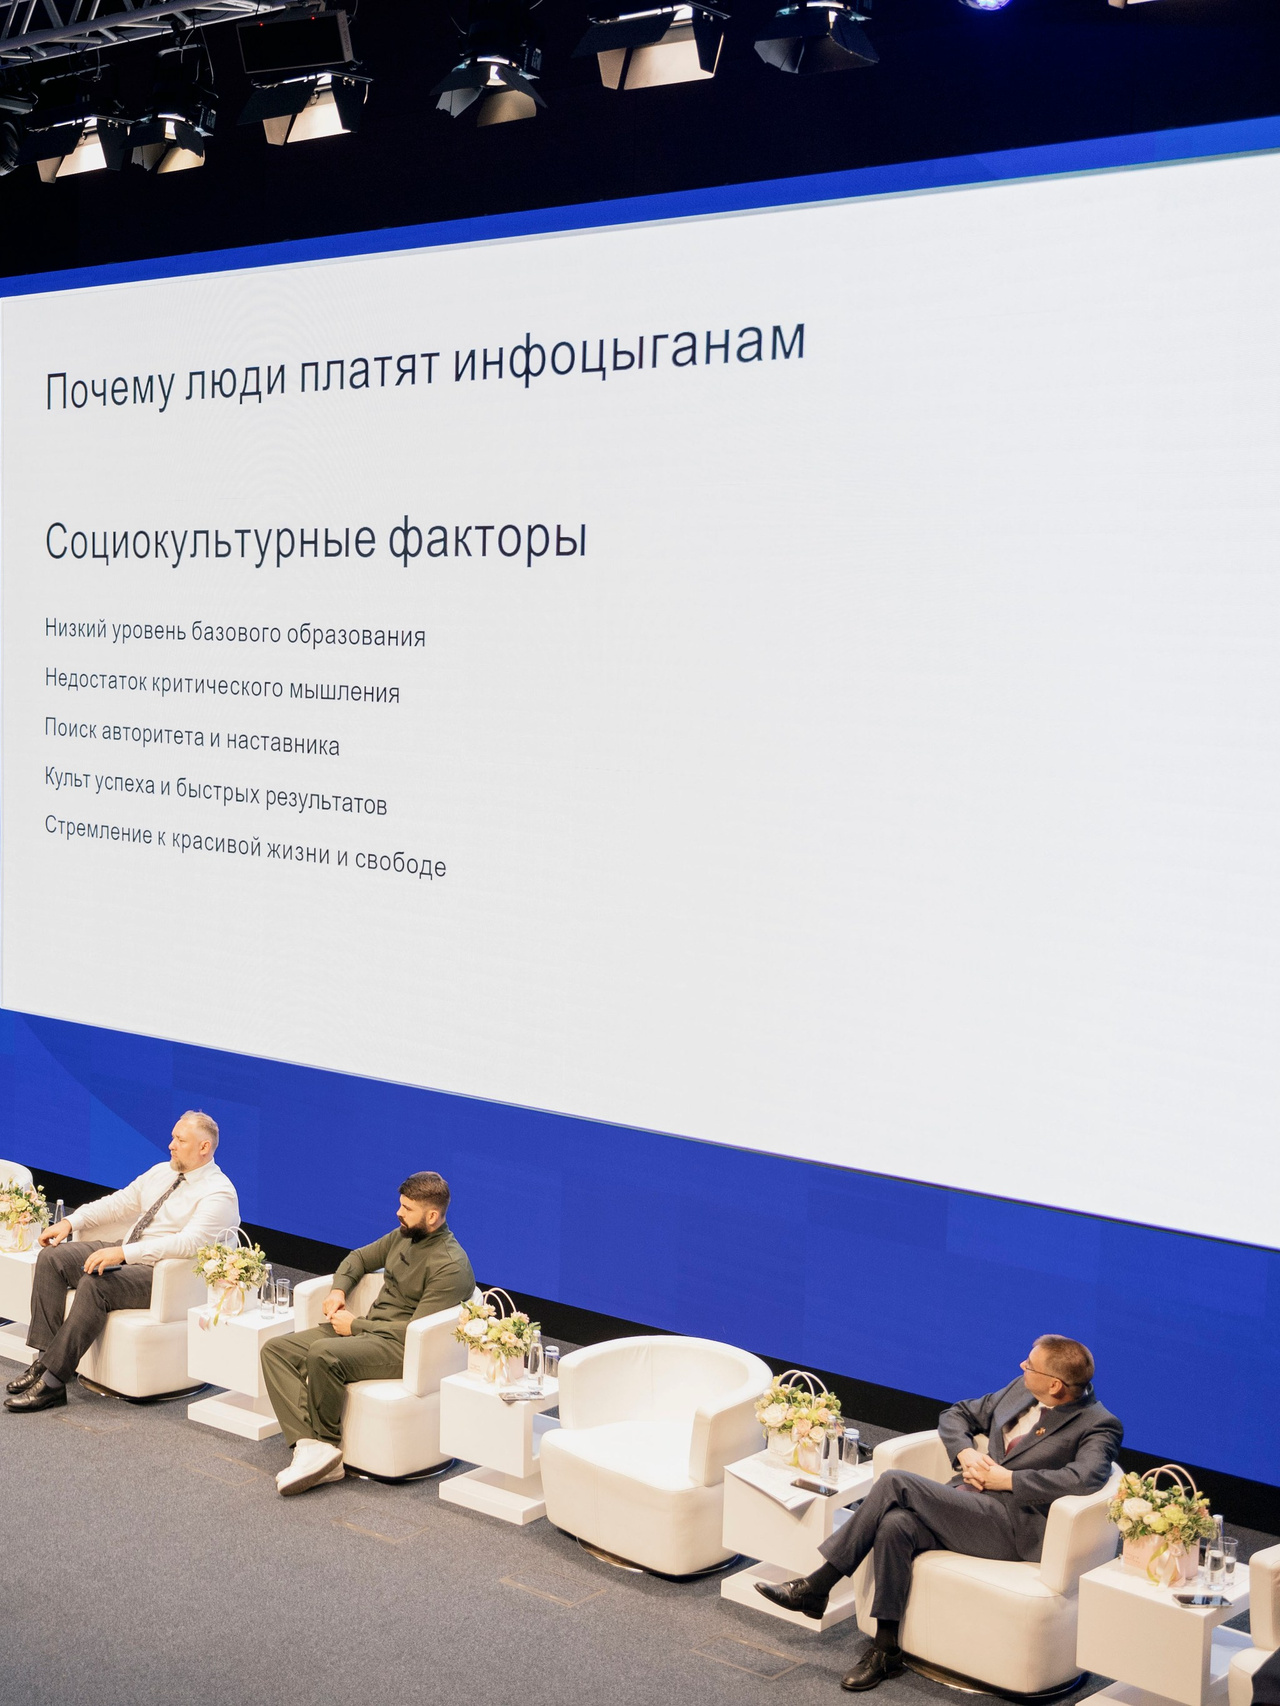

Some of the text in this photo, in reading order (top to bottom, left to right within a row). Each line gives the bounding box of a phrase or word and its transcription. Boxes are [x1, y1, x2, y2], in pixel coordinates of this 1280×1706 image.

[47, 323, 804, 413] Почему люди платят инфоцыганам
[46, 515, 585, 568] Социокультурные факторы
[46, 618, 425, 650] Низкий уровень базового образования
[46, 667, 399, 703] Недостаток критического мышления
[46, 717, 339, 756] Поиск авторитета и наставника
[46, 766, 387, 815] Культ успеха и быстрых результатов
[45, 815, 446, 880] Стремление к красивой жизни и свободе
